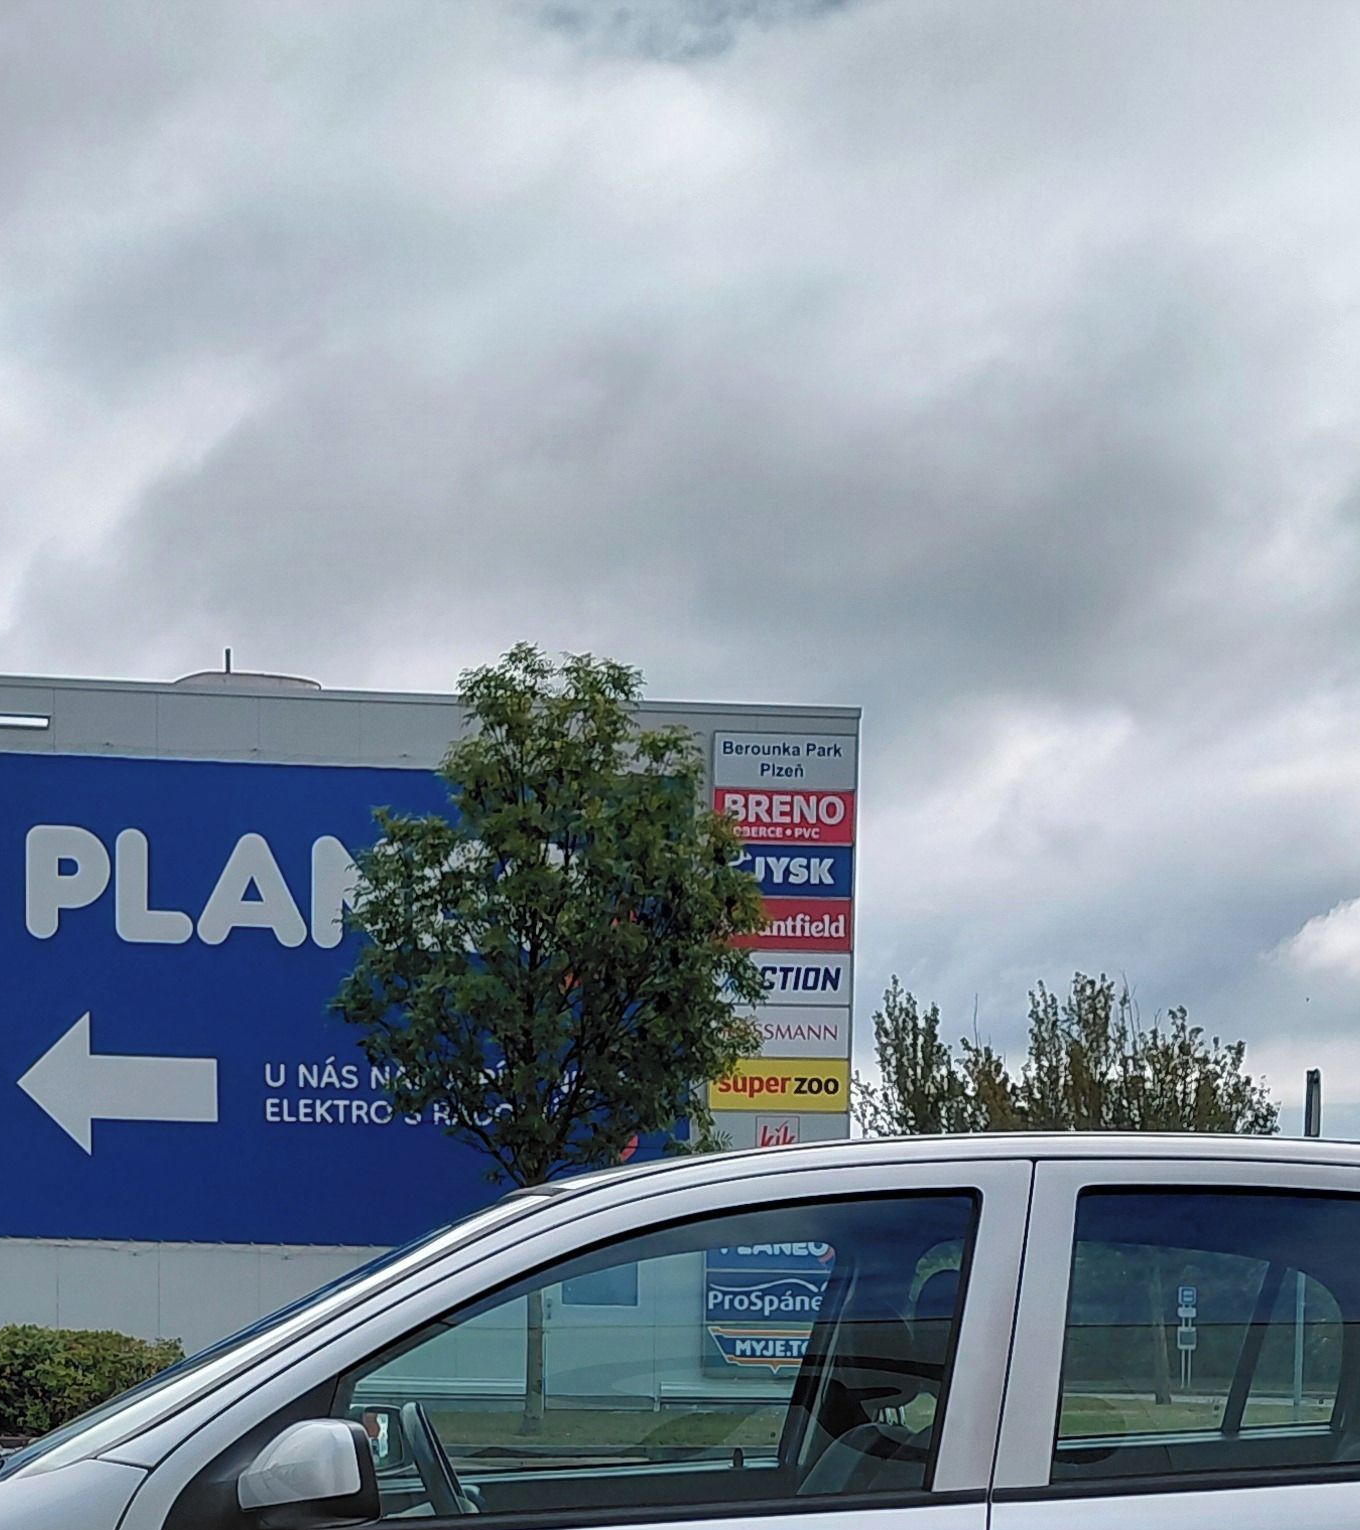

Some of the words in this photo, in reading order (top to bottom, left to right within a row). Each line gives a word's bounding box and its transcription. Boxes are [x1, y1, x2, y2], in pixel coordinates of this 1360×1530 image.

[722, 741, 801, 756] Berounka
[806, 743, 842, 757] Park
[760, 763, 804, 778] Plzeň
[724, 794, 845, 825] BRENO
[728, 827, 783, 838] OBERCE
[794, 828, 820, 839] PVC
[754, 857, 835, 884] JYSK
[746, 966, 841, 992] CTION
[265, 1064, 286, 1088] U
[298, 1056, 358, 1089] NÁS
[265, 1098, 394, 1125] ELEKTRO
[708, 1290, 824, 1316] ProSpáne
